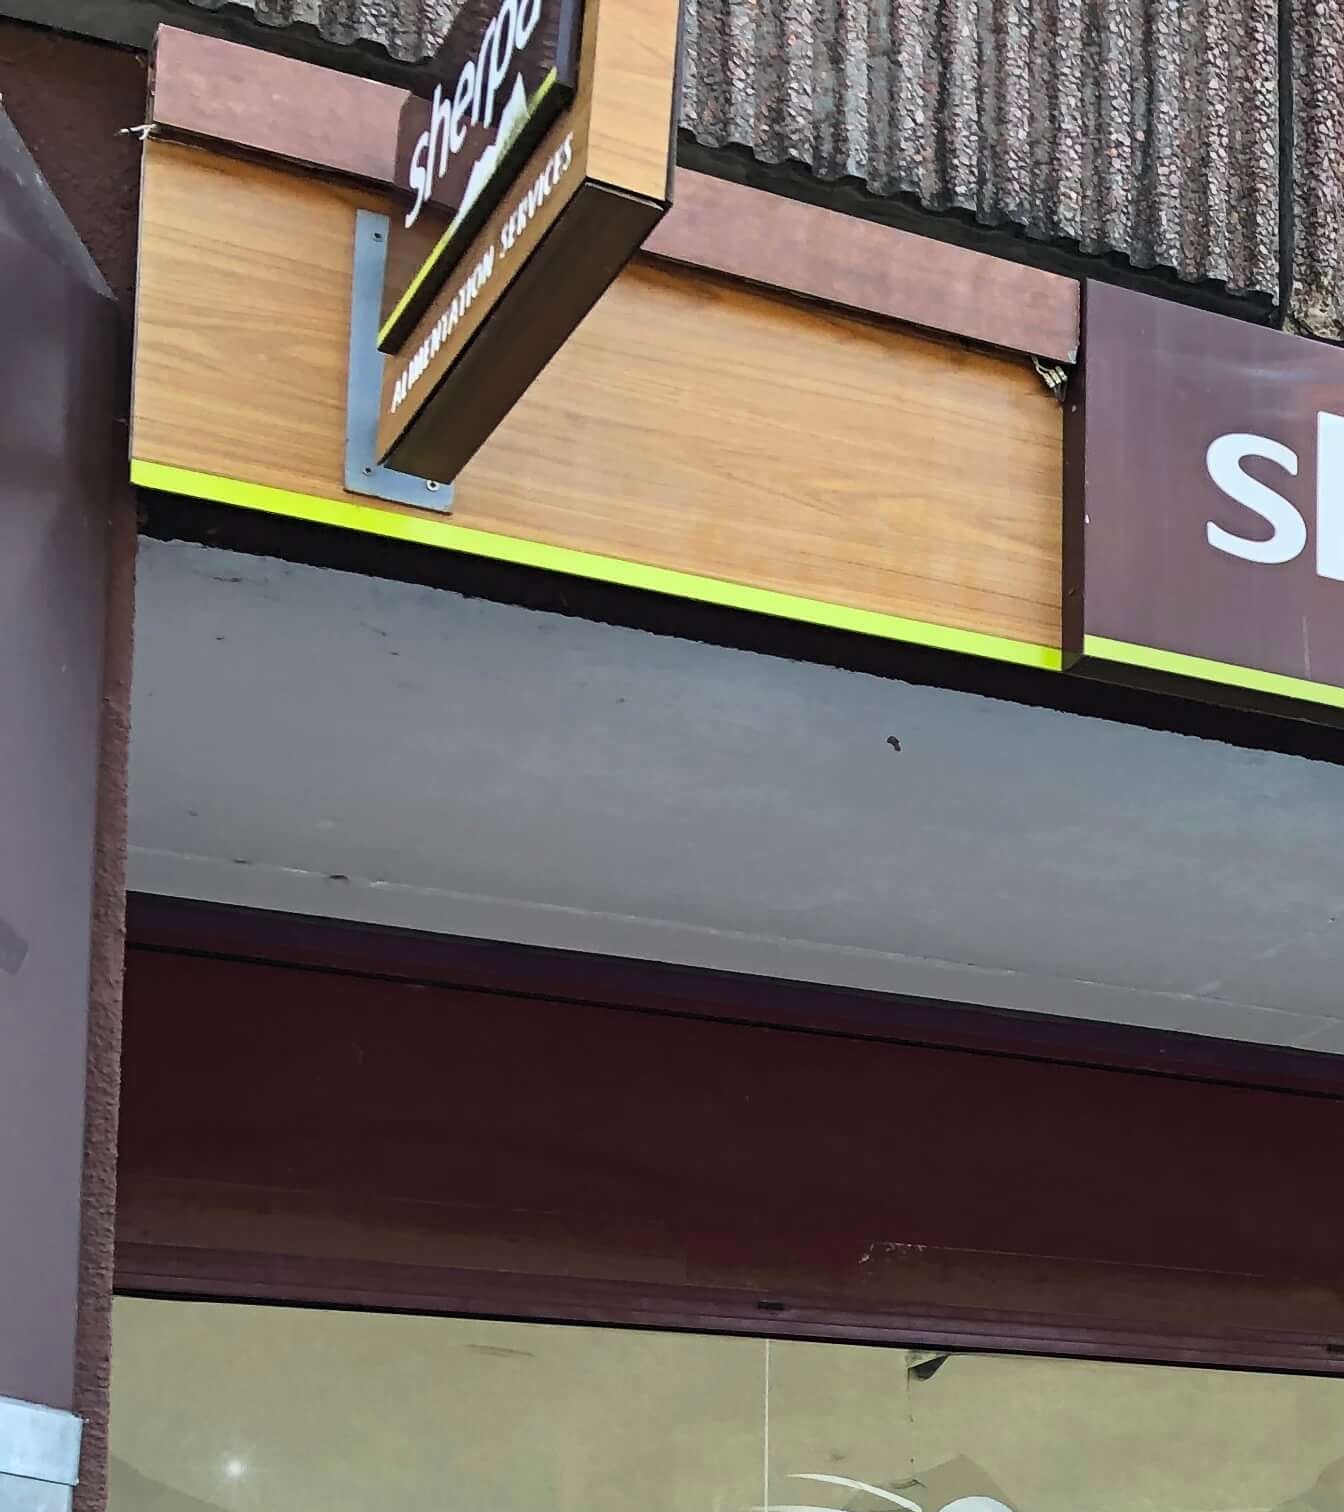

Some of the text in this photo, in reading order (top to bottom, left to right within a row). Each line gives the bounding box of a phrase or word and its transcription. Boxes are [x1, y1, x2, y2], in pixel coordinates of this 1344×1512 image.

[404, 0, 542, 229] sherpa
[391, 132, 574, 413] ALIMENTATION SERVICES
